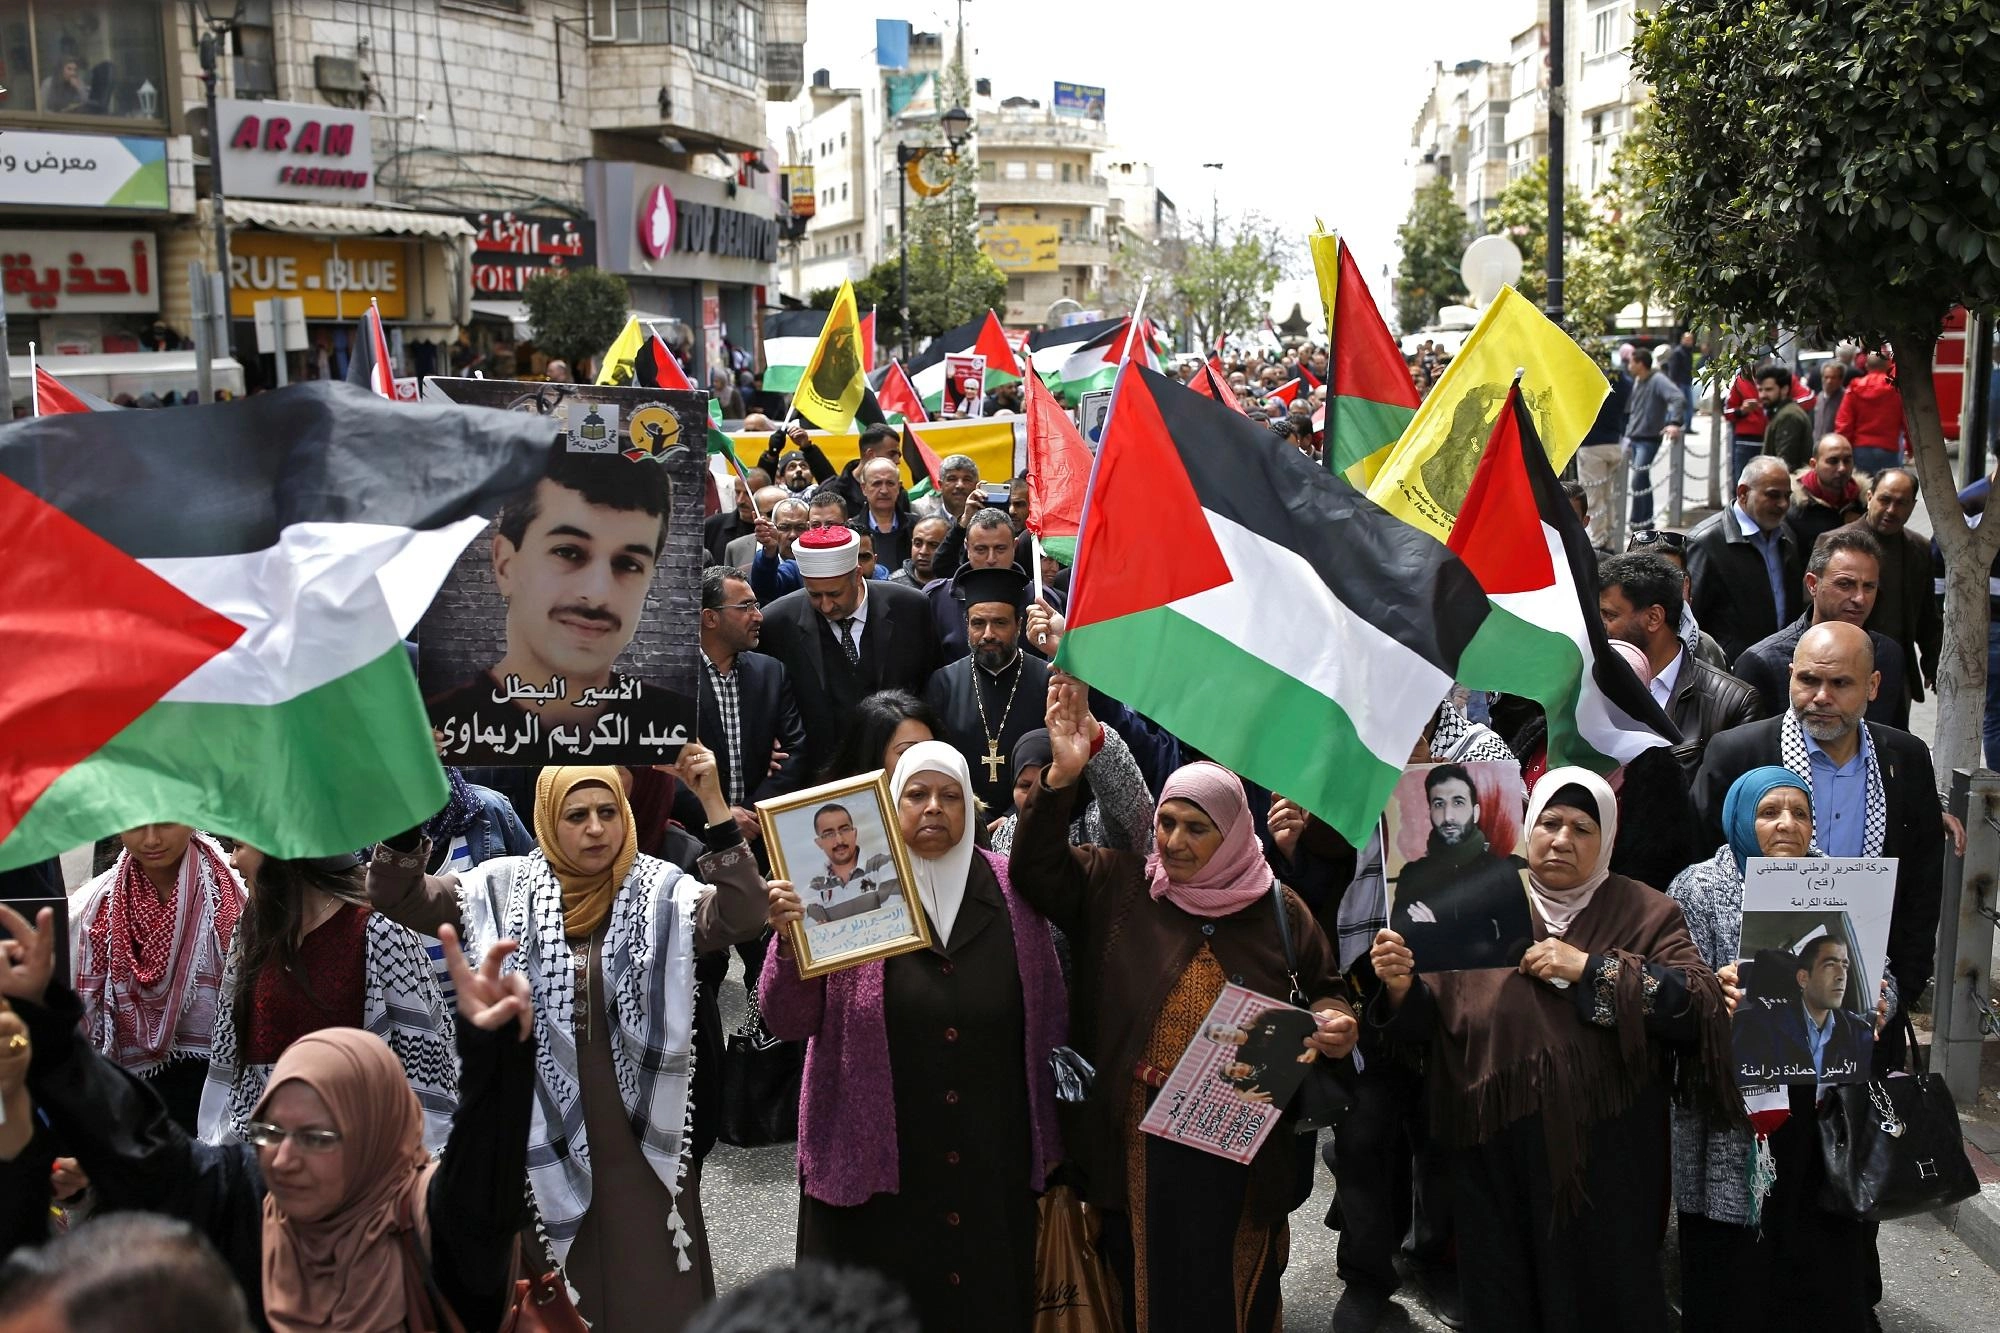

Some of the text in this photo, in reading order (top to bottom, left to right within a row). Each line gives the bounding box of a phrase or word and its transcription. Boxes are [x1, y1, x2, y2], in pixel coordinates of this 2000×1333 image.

[233, 115, 354, 157] ARAM
[24, 151, 97, 174] معرض
[280, 166, 368, 189] FASHION
[679, 199, 715, 254] TOP
[2, 239, 150, 309] أحذية
[326, 256, 397, 292] BLUE
[491, 674, 643, 707] الأسير البطل
[439, 711, 689, 759] عبد الكريم الريماوي
[1756, 862, 1889, 875] حركة التحرير الوطني الفلسطيني
[1790, 897, 1848, 909] منطقة الكرامة
[1740, 1058, 1857, 1079] الأسير حمادة درامنة
[1238, 1114, 1265, 1146] 2002
